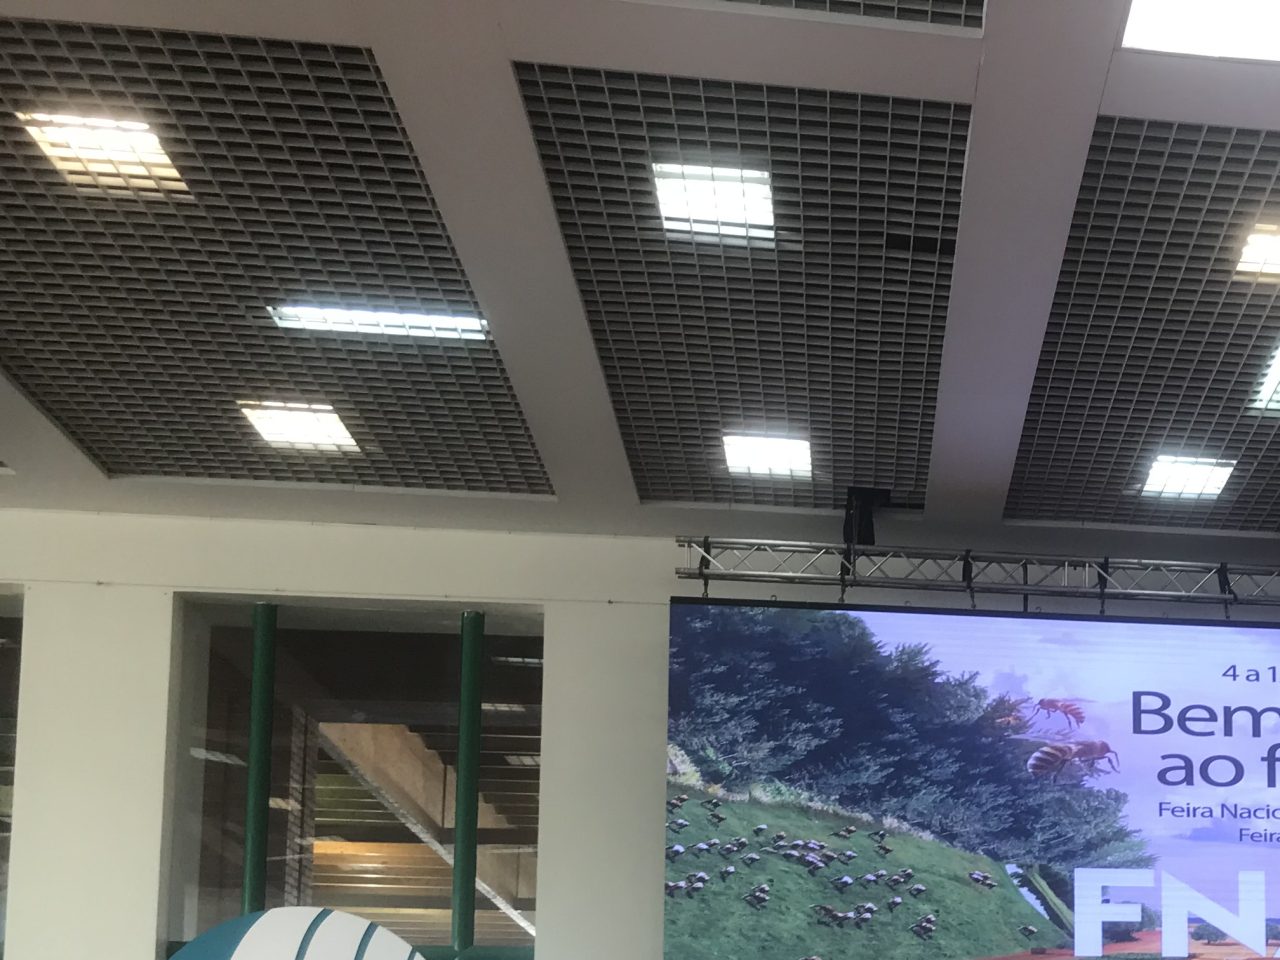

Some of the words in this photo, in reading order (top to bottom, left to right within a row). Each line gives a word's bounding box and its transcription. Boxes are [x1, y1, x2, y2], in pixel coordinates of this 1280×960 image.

[1221, 664, 1239, 682] 4
[1245, 669, 1261, 683] a
[1156, 752, 1245, 788] ao
[1158, 801, 1214, 819] Feira
